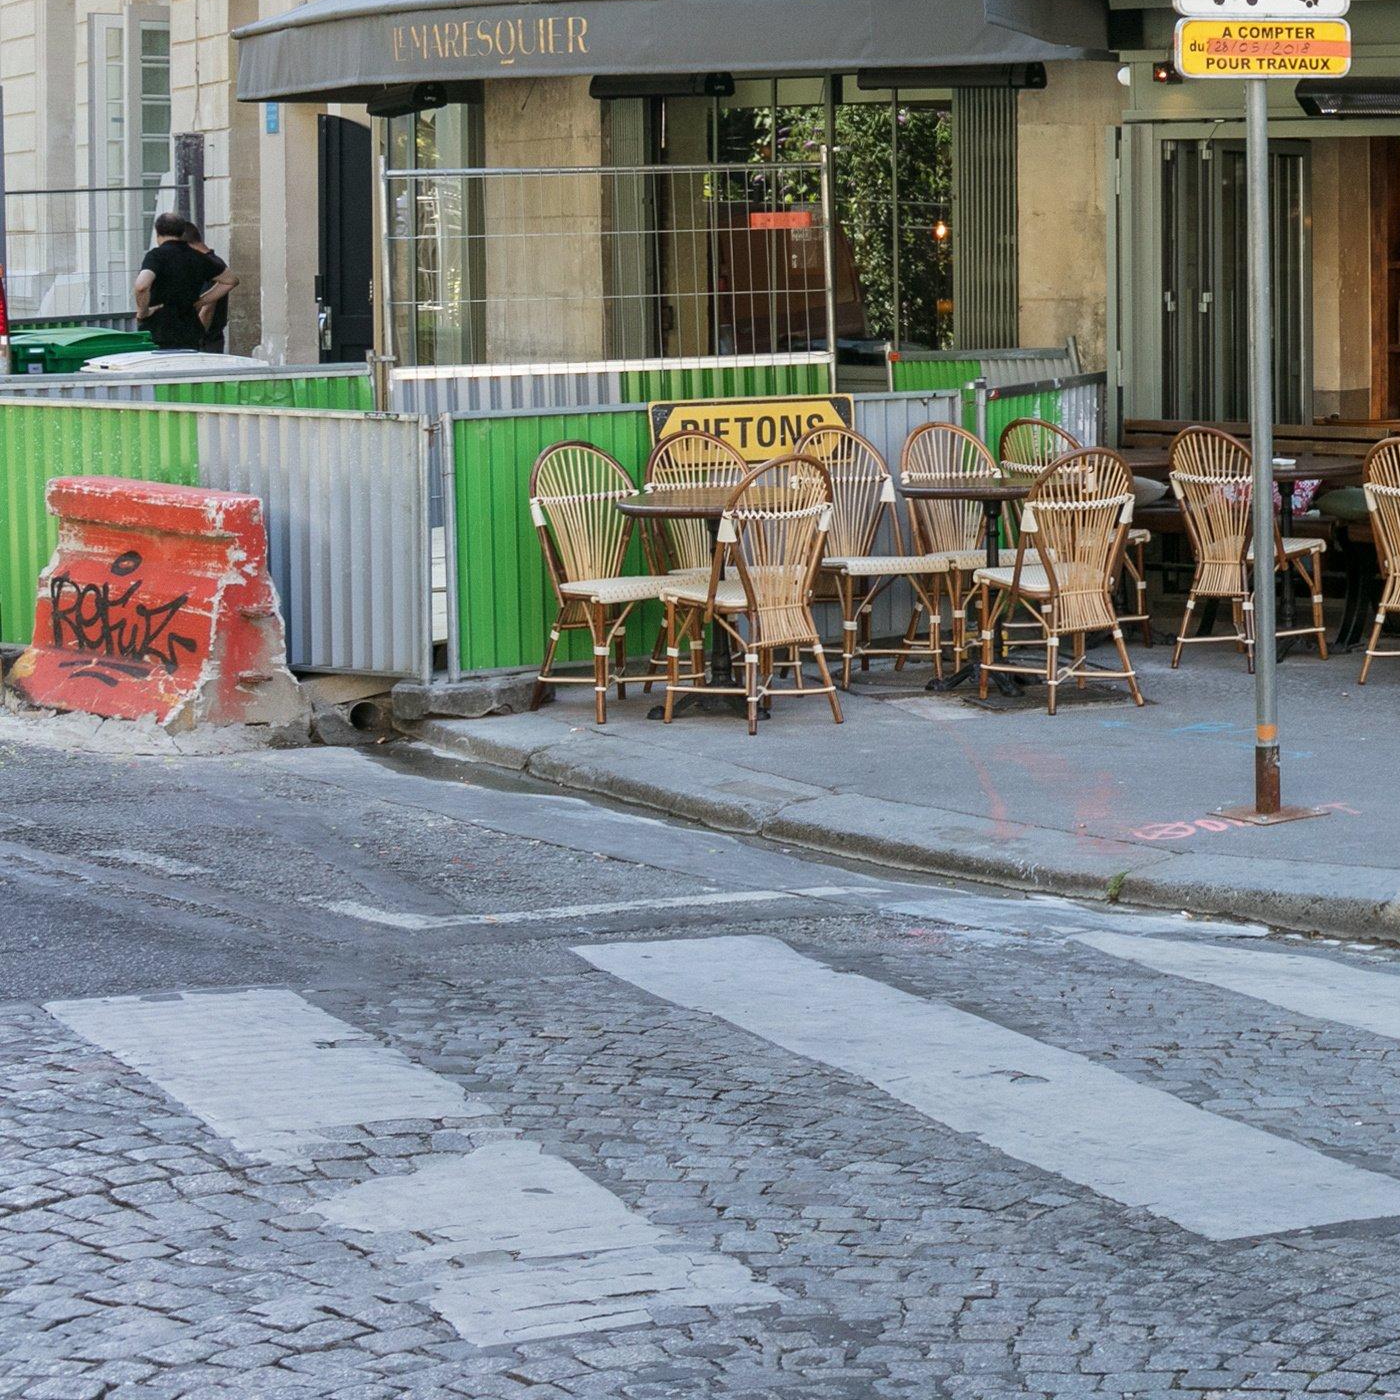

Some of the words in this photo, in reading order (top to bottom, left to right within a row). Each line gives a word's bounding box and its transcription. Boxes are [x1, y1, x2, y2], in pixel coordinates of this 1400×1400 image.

[1222, 26, 1232, 39] A
[1238, 26, 1315, 39] COMPTER
[393, 25, 408, 62] LE
[411, 16, 590, 65] MARESQUIER
[1189, 40, 1205, 52] du
[1206, 58, 1250, 70] POUR
[1256, 58, 1330, 70] TRAVAUX
